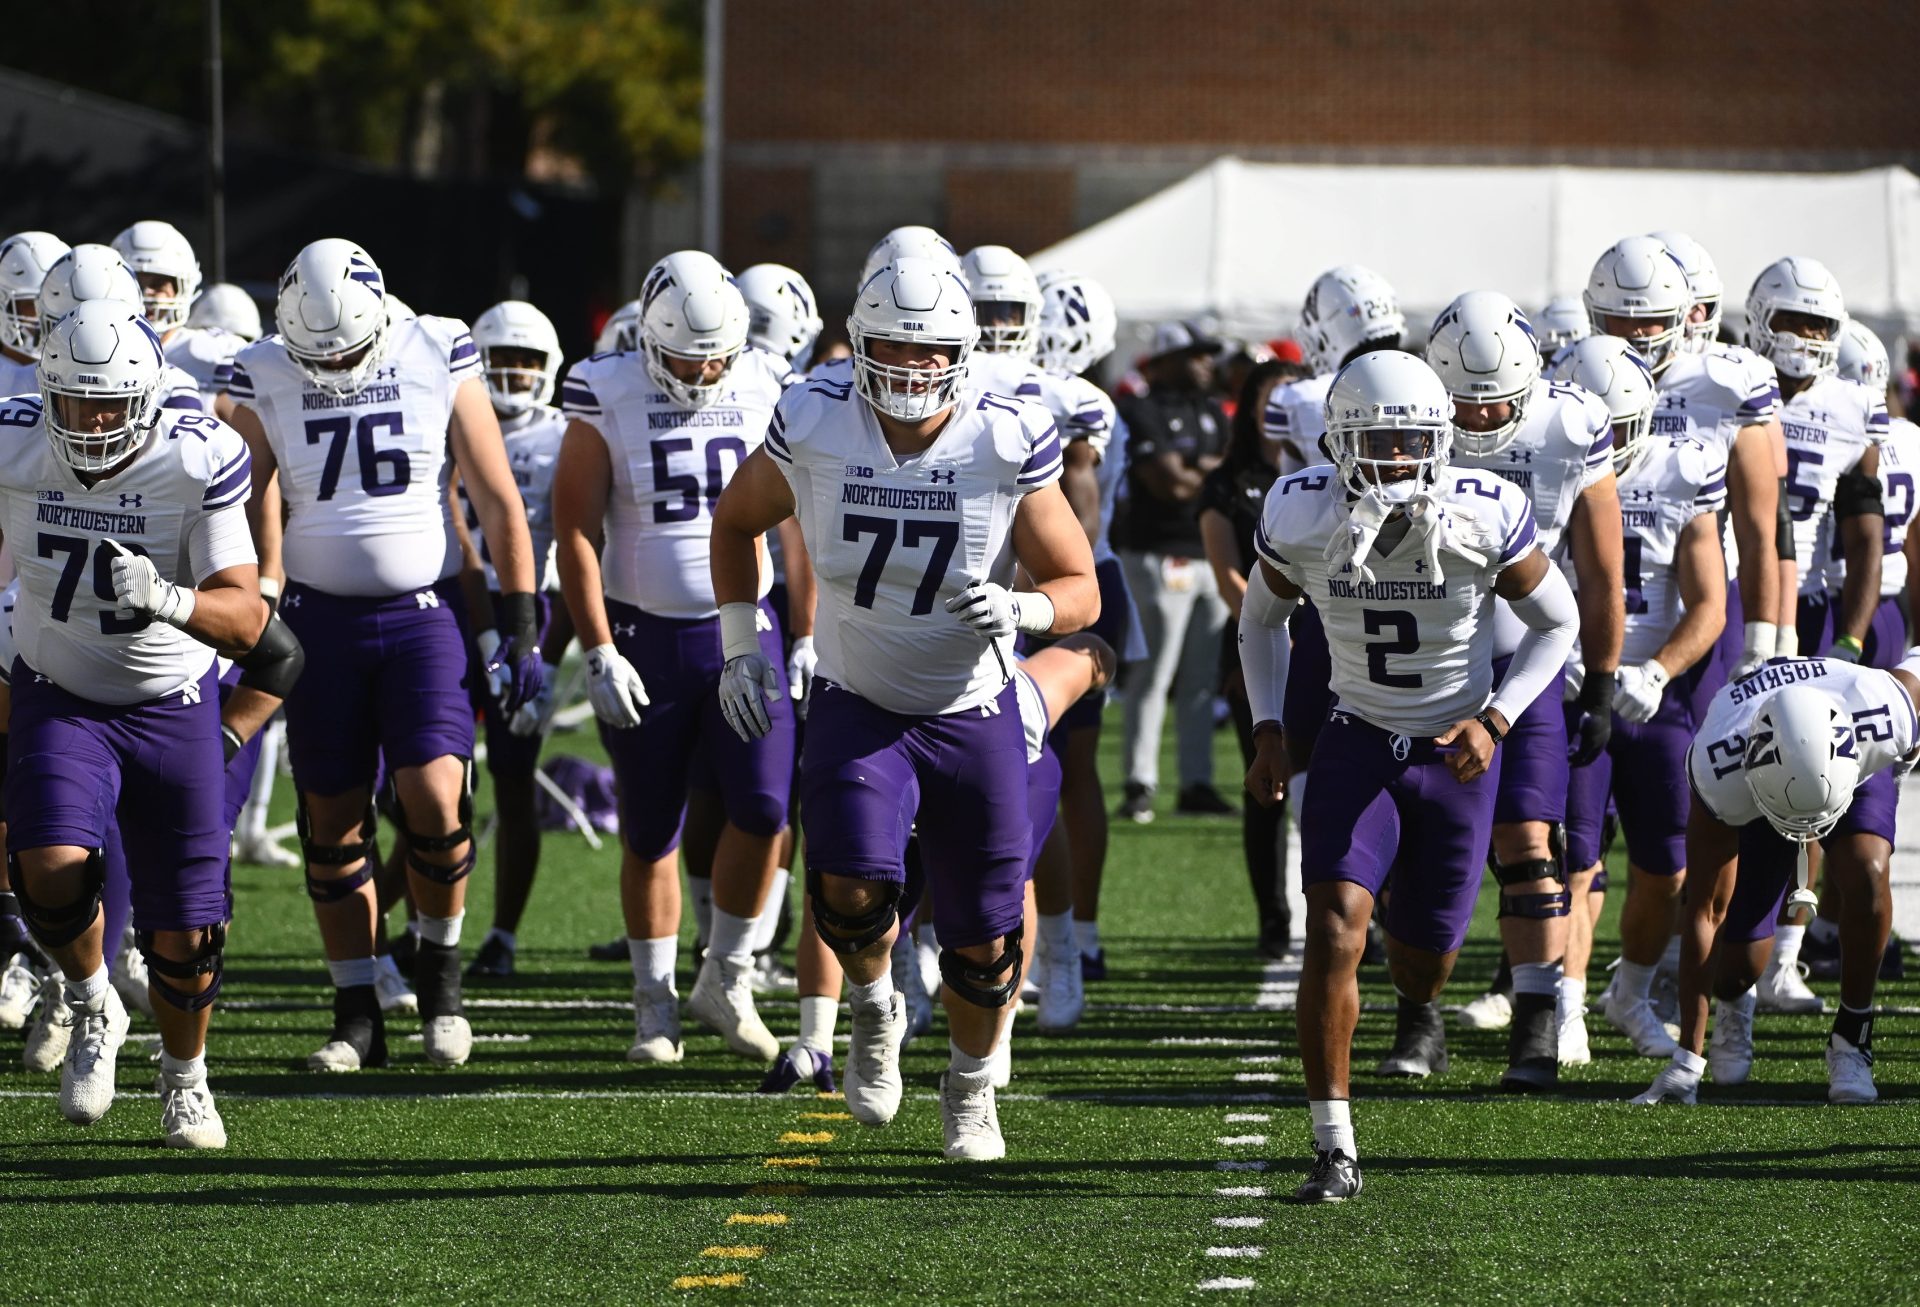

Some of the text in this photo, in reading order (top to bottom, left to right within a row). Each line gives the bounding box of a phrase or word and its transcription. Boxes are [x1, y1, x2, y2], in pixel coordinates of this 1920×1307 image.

[903, 322, 925, 332] W.I.N.
[78, 375, 99, 385] W.I.N.
[169, 415, 220, 443] 79
[647, 410, 745, 430] NORTHWESTERN
[304, 411, 411, 501] 76
[651, 437, 748, 523] 50
[1282, 475, 1329, 495] 2
[1456, 478, 1501, 500] 2
[842, 483, 957, 511] NORTHWESTERN
[37, 503, 146, 534] NORTHWESTERN
[843, 514, 960, 616] 77
[37, 532, 152, 635] 79
[1328, 579, 1447, 601] NORTHWESTERN
[1363, 608, 1423, 688] 2
[1730, 662, 1828, 705] HASKINS
[1852, 704, 1894, 743] 21
[1706, 733, 1748, 780] 21
